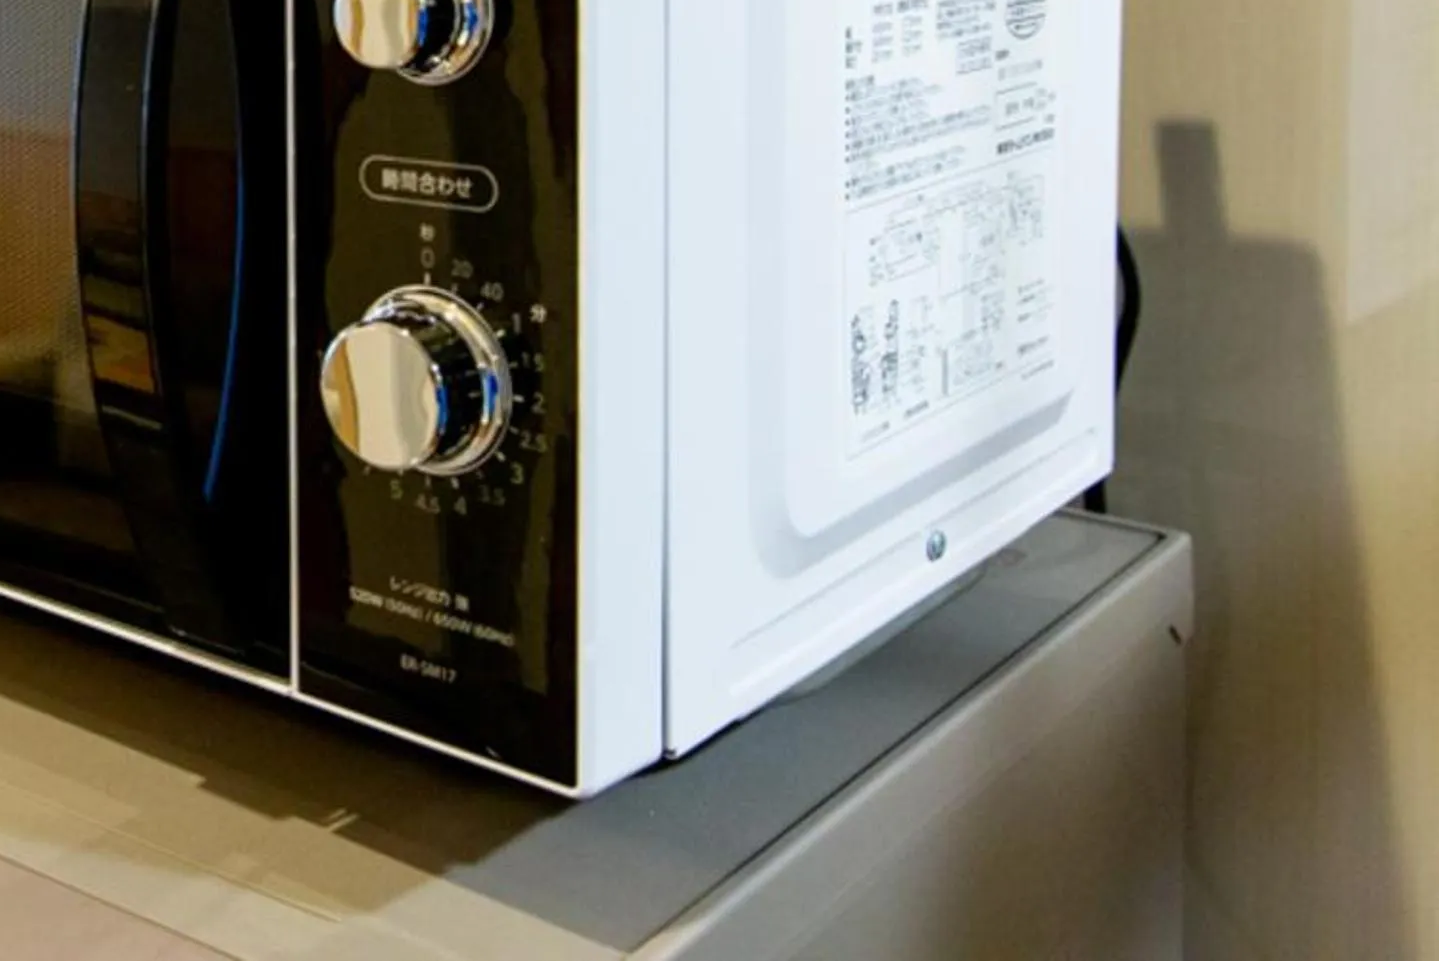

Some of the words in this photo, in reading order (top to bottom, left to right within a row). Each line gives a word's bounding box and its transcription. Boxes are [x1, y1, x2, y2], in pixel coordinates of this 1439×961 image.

[380, 167, 473, 198] 時間合わせ
[450, 259, 473, 279] 20
[480, 282, 504, 302] 40
[532, 393, 546, 414] 2
[512, 463, 524, 484] 3
[454, 495, 467, 516] 4
